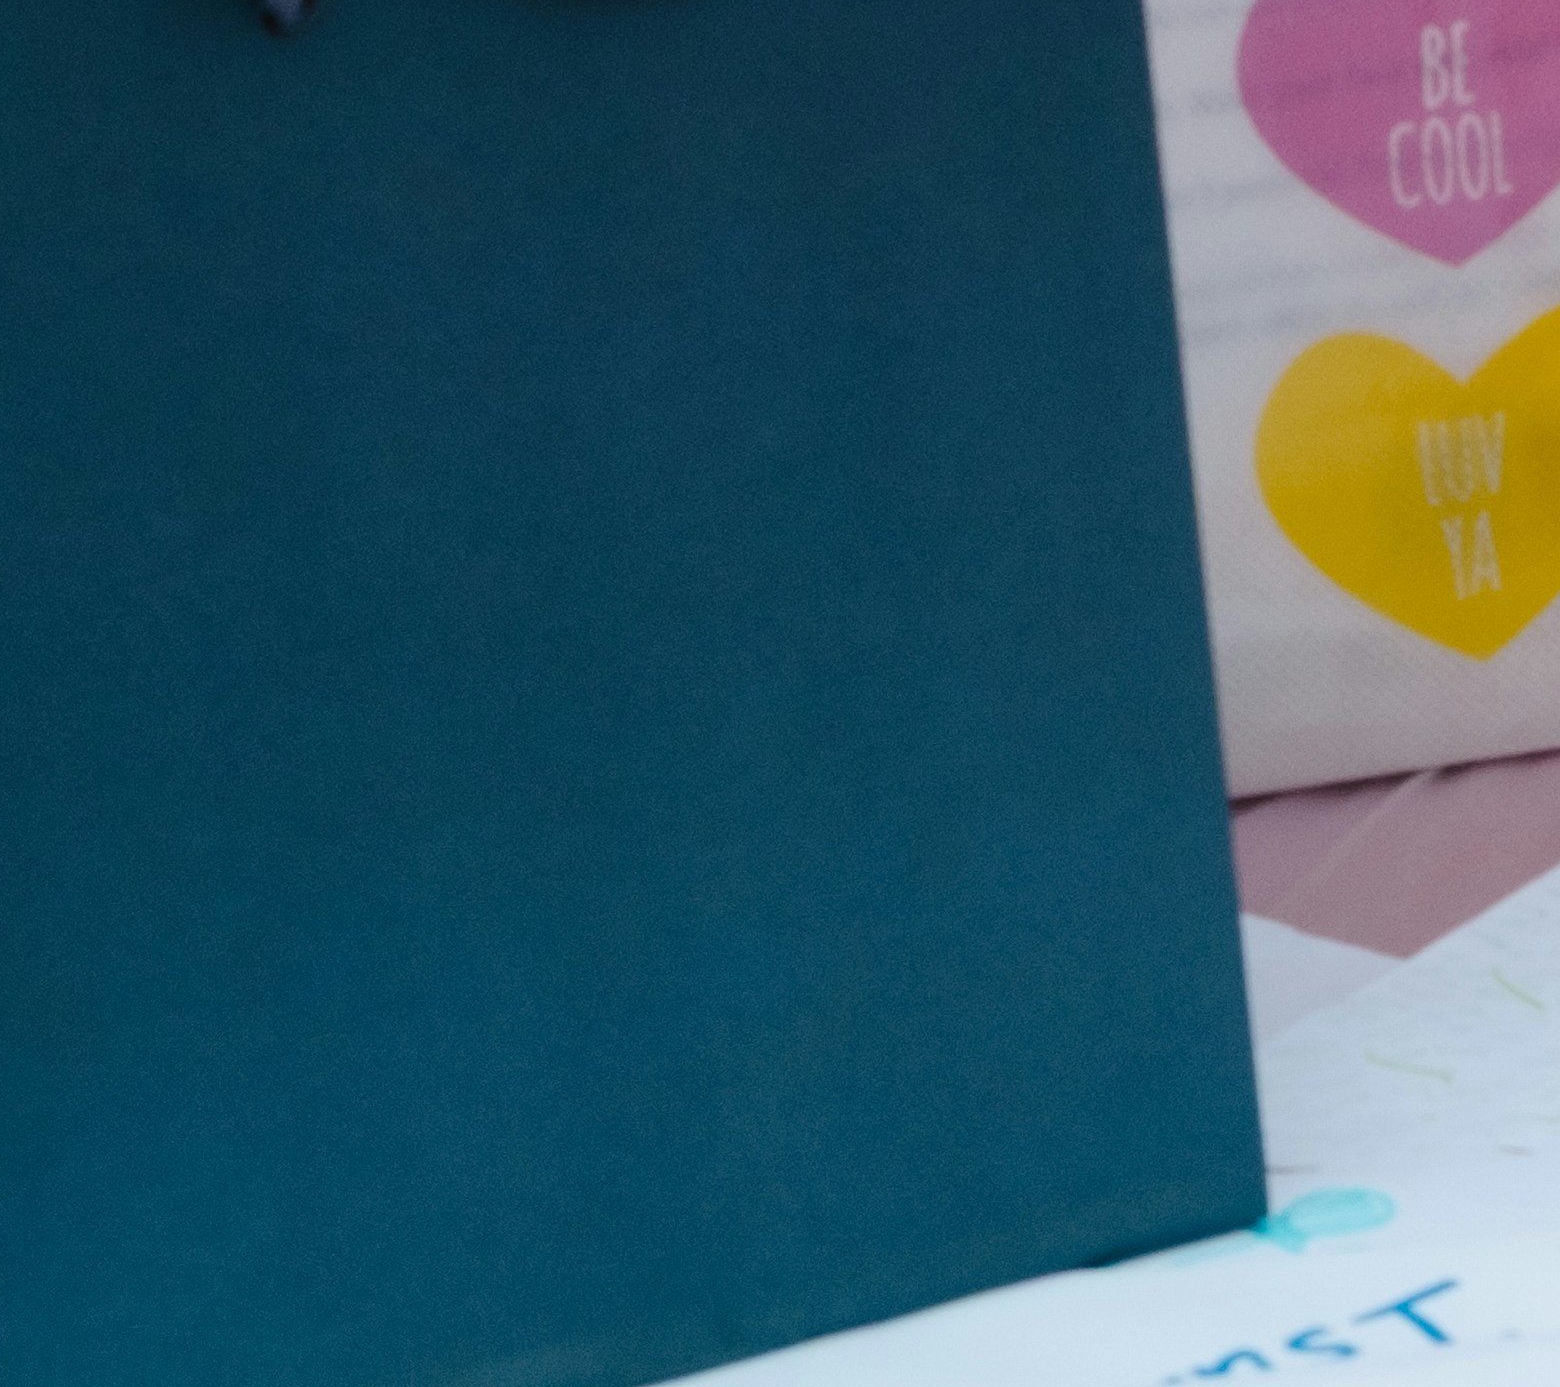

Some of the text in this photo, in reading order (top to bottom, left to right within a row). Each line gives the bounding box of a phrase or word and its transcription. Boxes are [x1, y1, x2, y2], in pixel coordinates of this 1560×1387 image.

[1419, 19, 1476, 113] BE
[1386, 109, 1514, 210] COOL
[1439, 507, 1503, 604] YA
